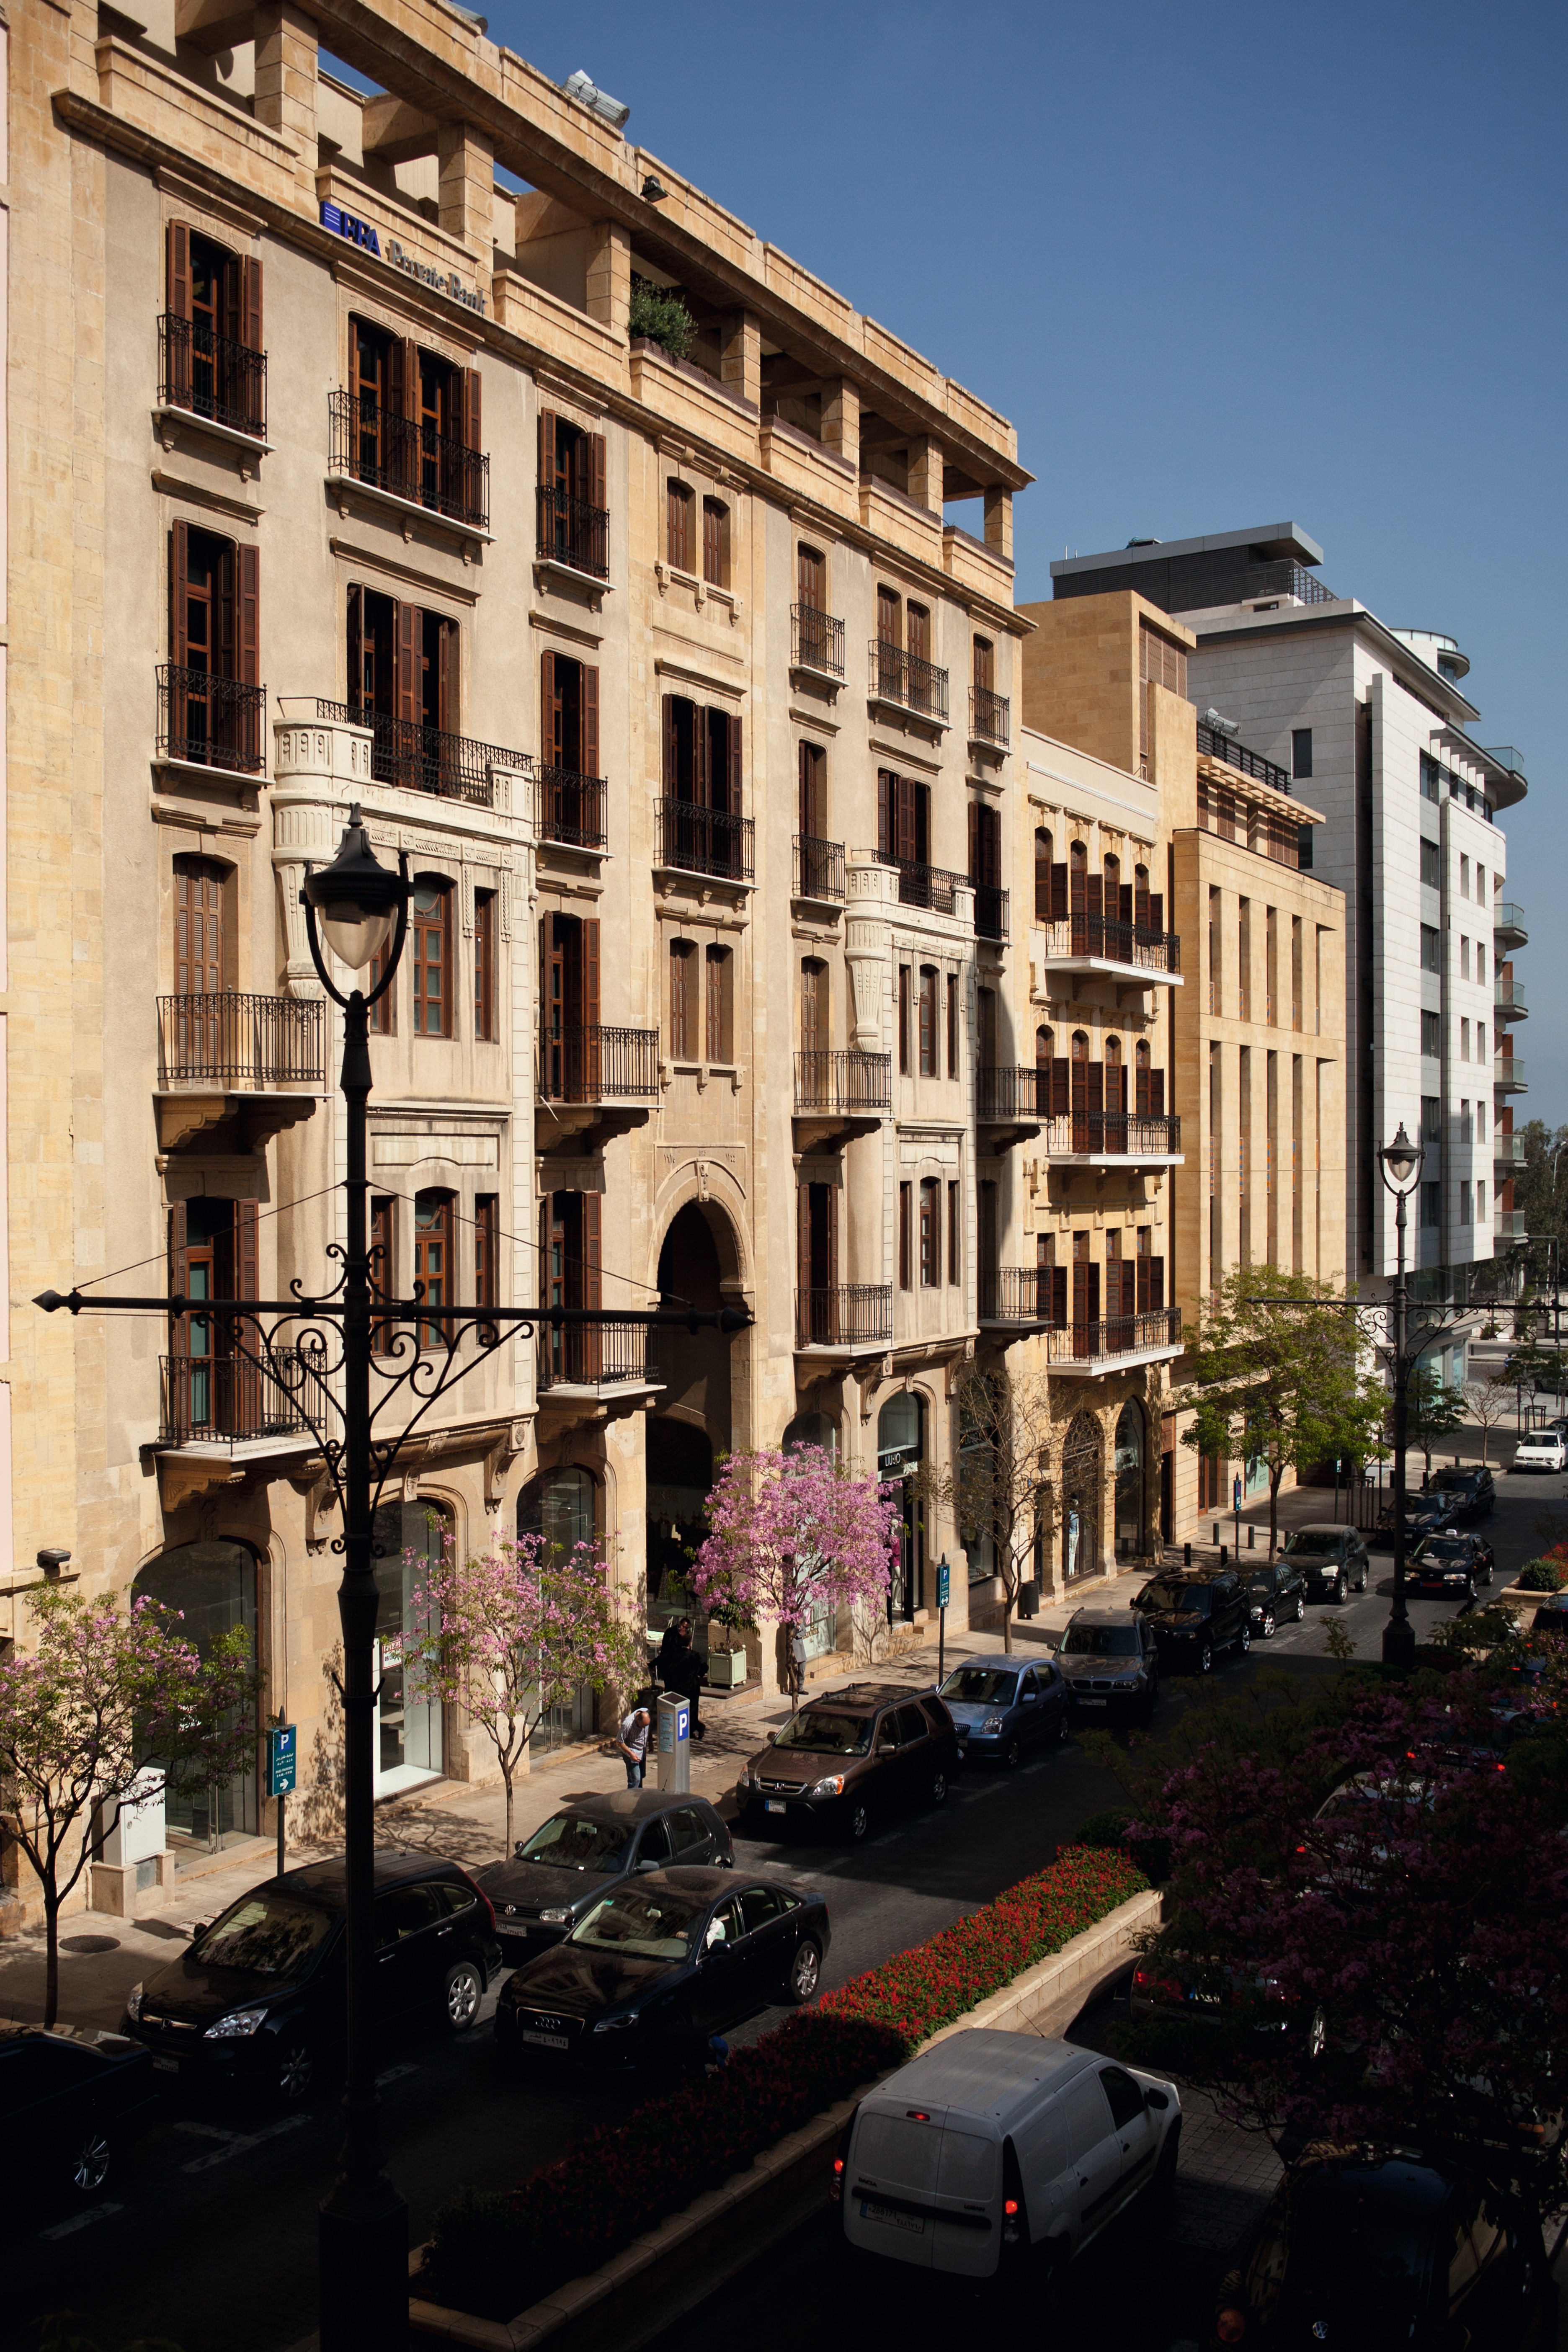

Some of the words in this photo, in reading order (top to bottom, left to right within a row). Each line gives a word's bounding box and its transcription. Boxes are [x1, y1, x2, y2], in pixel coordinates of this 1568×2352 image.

[341, 211, 381, 257] FFA
[388, 239, 446, 292] Private
[448, 272, 488, 315] Bank
[943, 1570, 947, 1579] P
[679, 1713, 687, 1736] P
[281, 1734, 289, 1750] P
[858, 2177, 877, 2187] DACIA
[872, 2205, 897, 2218] 288171
